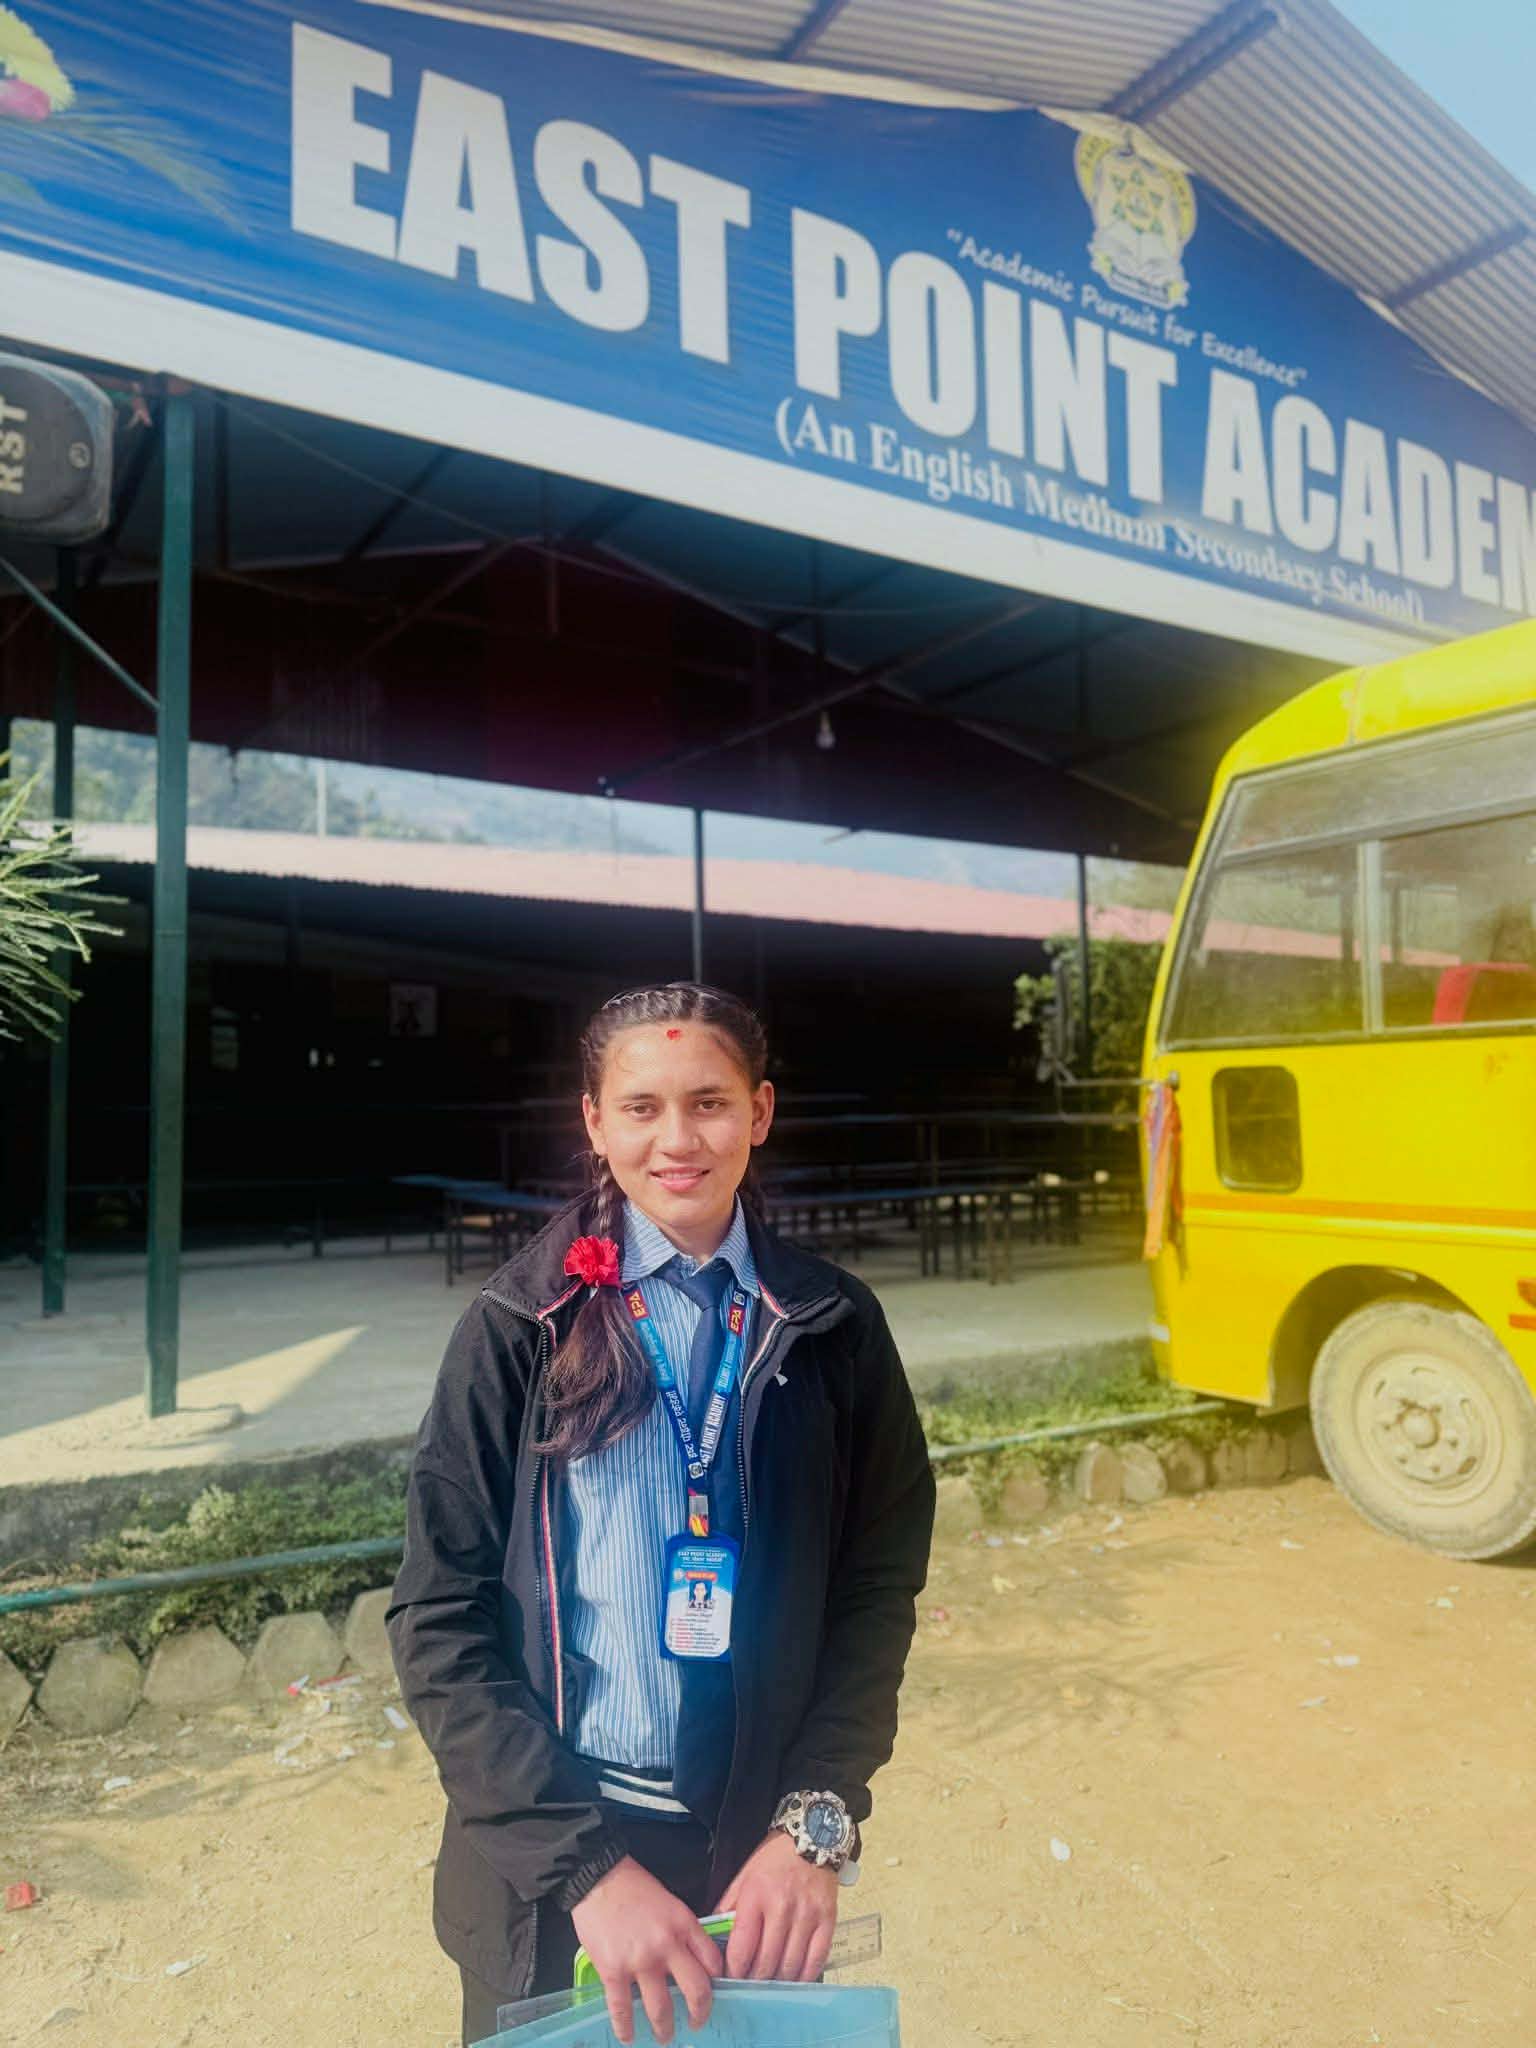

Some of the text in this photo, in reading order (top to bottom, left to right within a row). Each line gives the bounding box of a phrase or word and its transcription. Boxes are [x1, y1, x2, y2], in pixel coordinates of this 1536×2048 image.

[292, 21, 750, 364] EAST
[792, 207, 1177, 505] POINT
[1081, 284, 1159, 336] Pursuit
[1164, 314, 1197, 347] for
[775, 397, 858, 462] (An
[870, 423, 1014, 510] English
[1023, 471, 1167, 552] Medium
[1174, 517, 1325, 605] Secondary
[629, 1291, 648, 1319] EPA
[729, 1308, 743, 1333] EPA
[706, 1393, 727, 1427] ACADEMY
[700, 1426, 718, 1449] POINT
